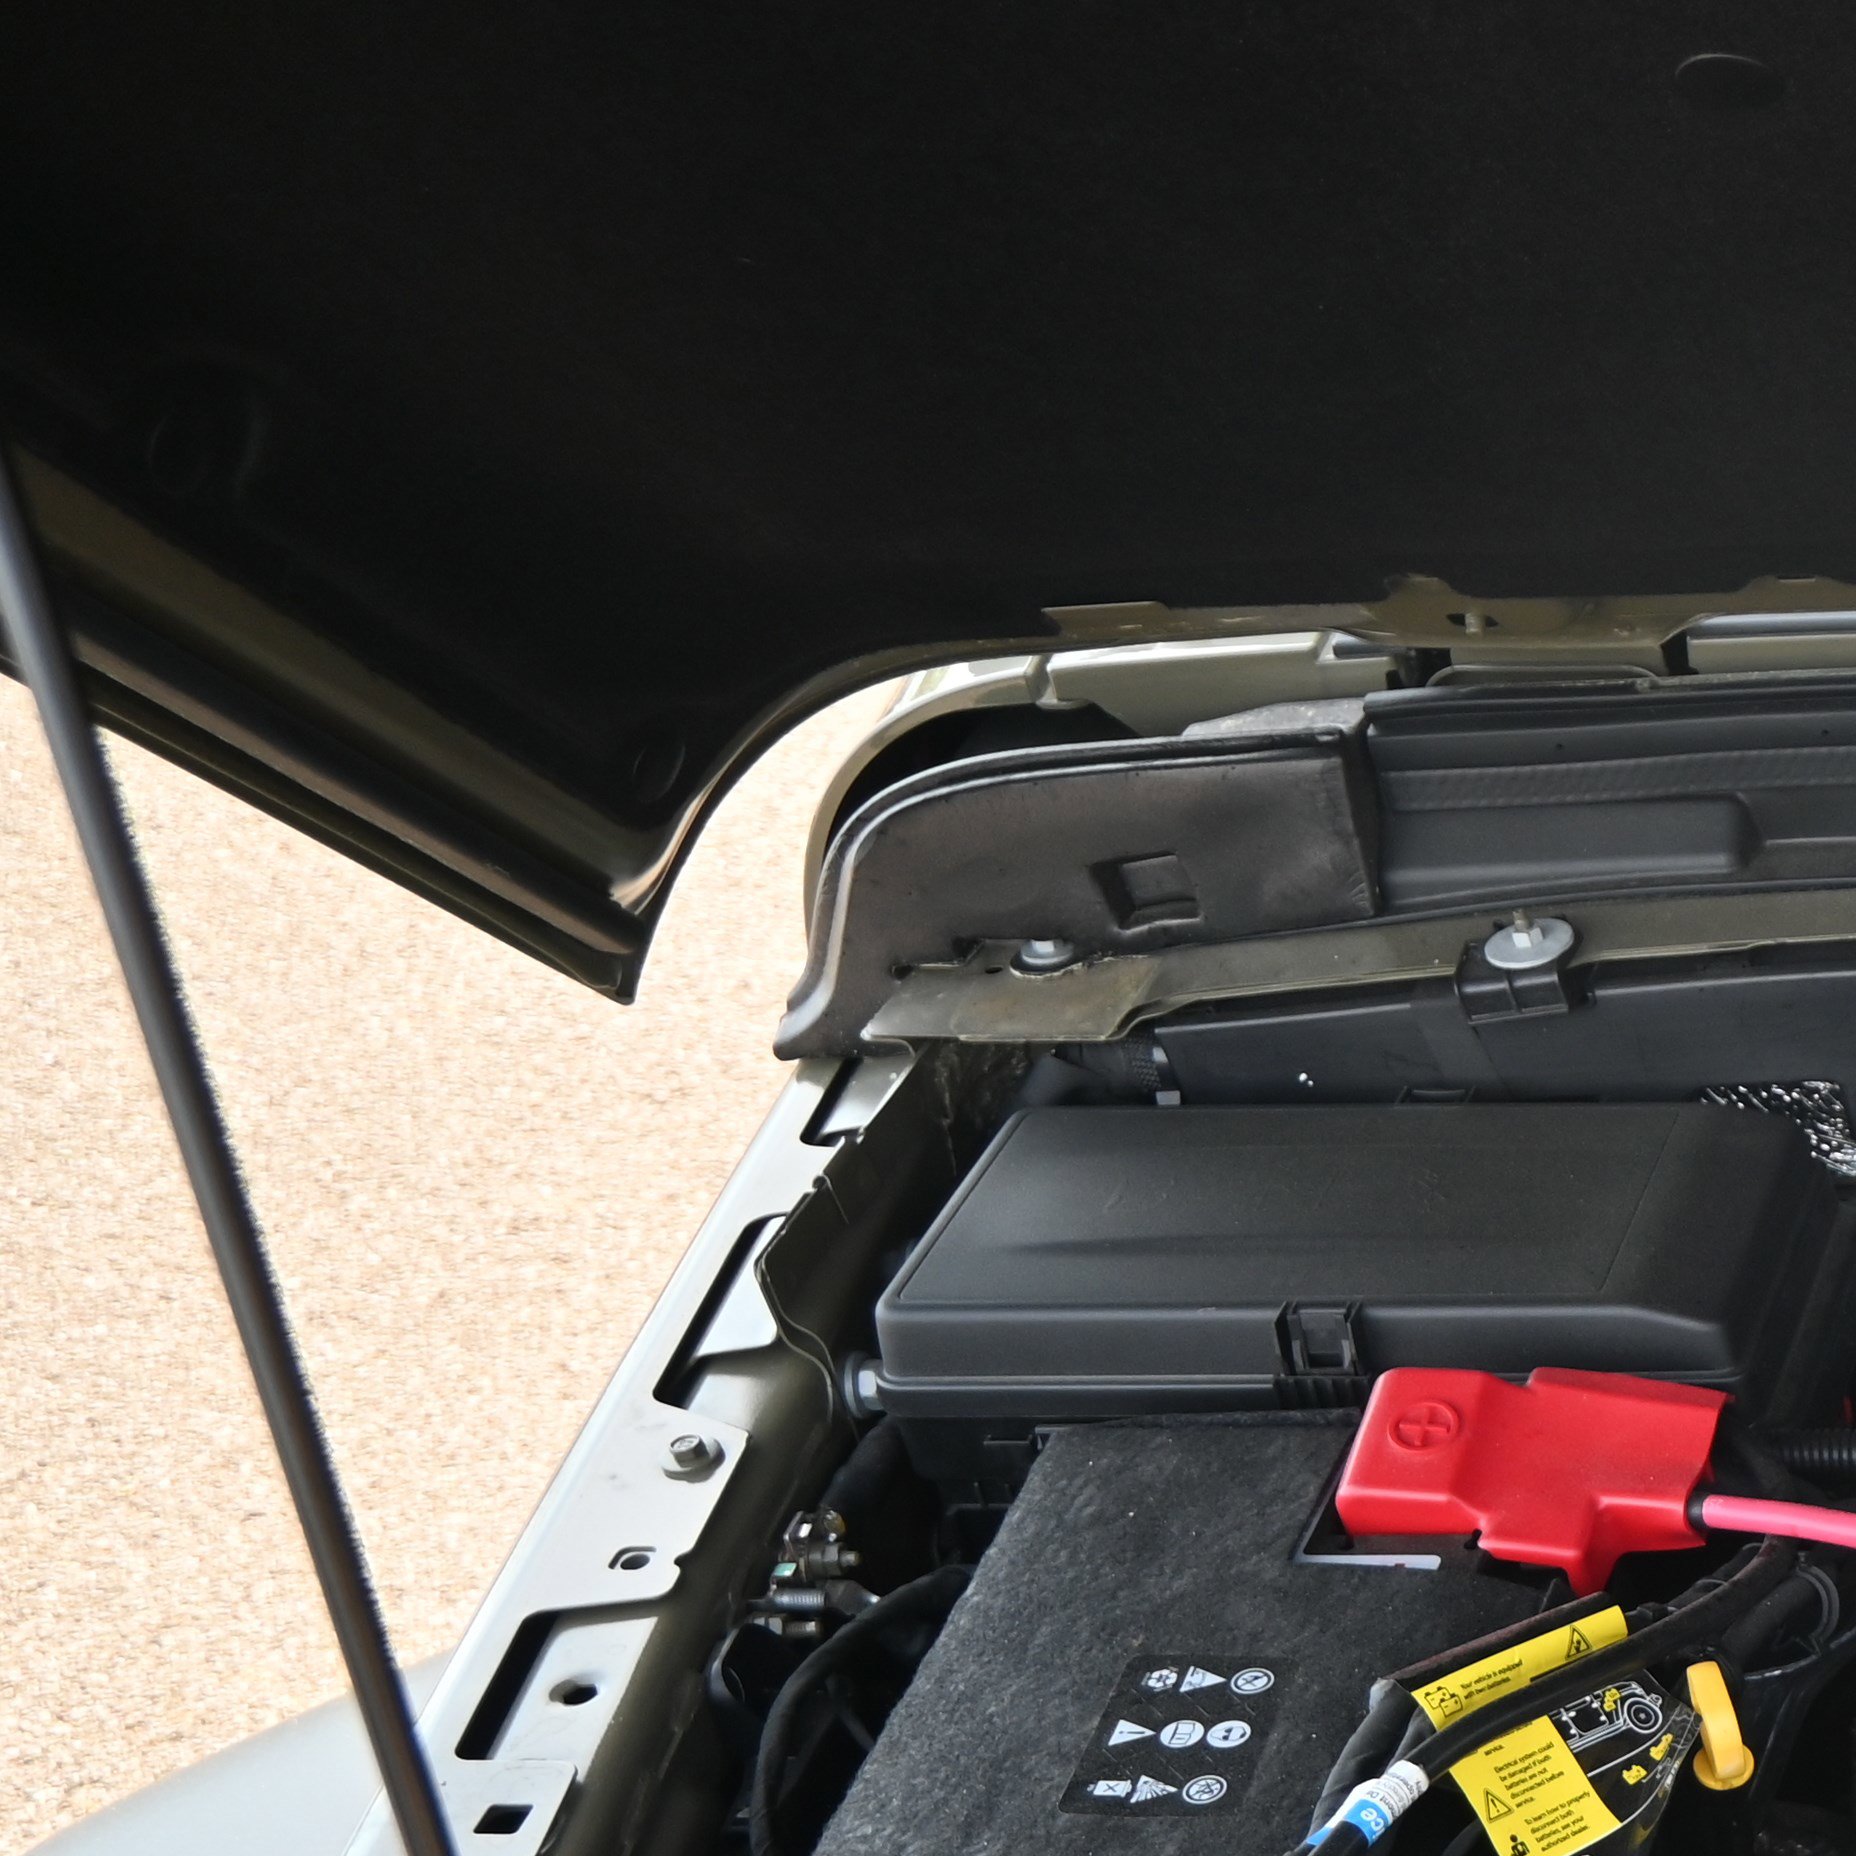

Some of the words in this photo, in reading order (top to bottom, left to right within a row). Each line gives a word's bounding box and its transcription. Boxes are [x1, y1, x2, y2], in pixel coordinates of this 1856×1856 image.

[1494, 1760, 1518, 1773] Electrical
[1519, 1751, 1537, 1763] system
[1538, 1742, 1554, 1754] could
[1508, 1763, 1532, 1779] damaged
[1537, 1754, 1552, 1764] both
[1504, 1777, 1528, 1791] batteries
[1538, 1767, 1548, 1776] not
[1510, 1780, 1545, 1800] disconnected
[1532, 1812, 1547, 1821] learn
[1567, 1791, 1590, 1806] properly
